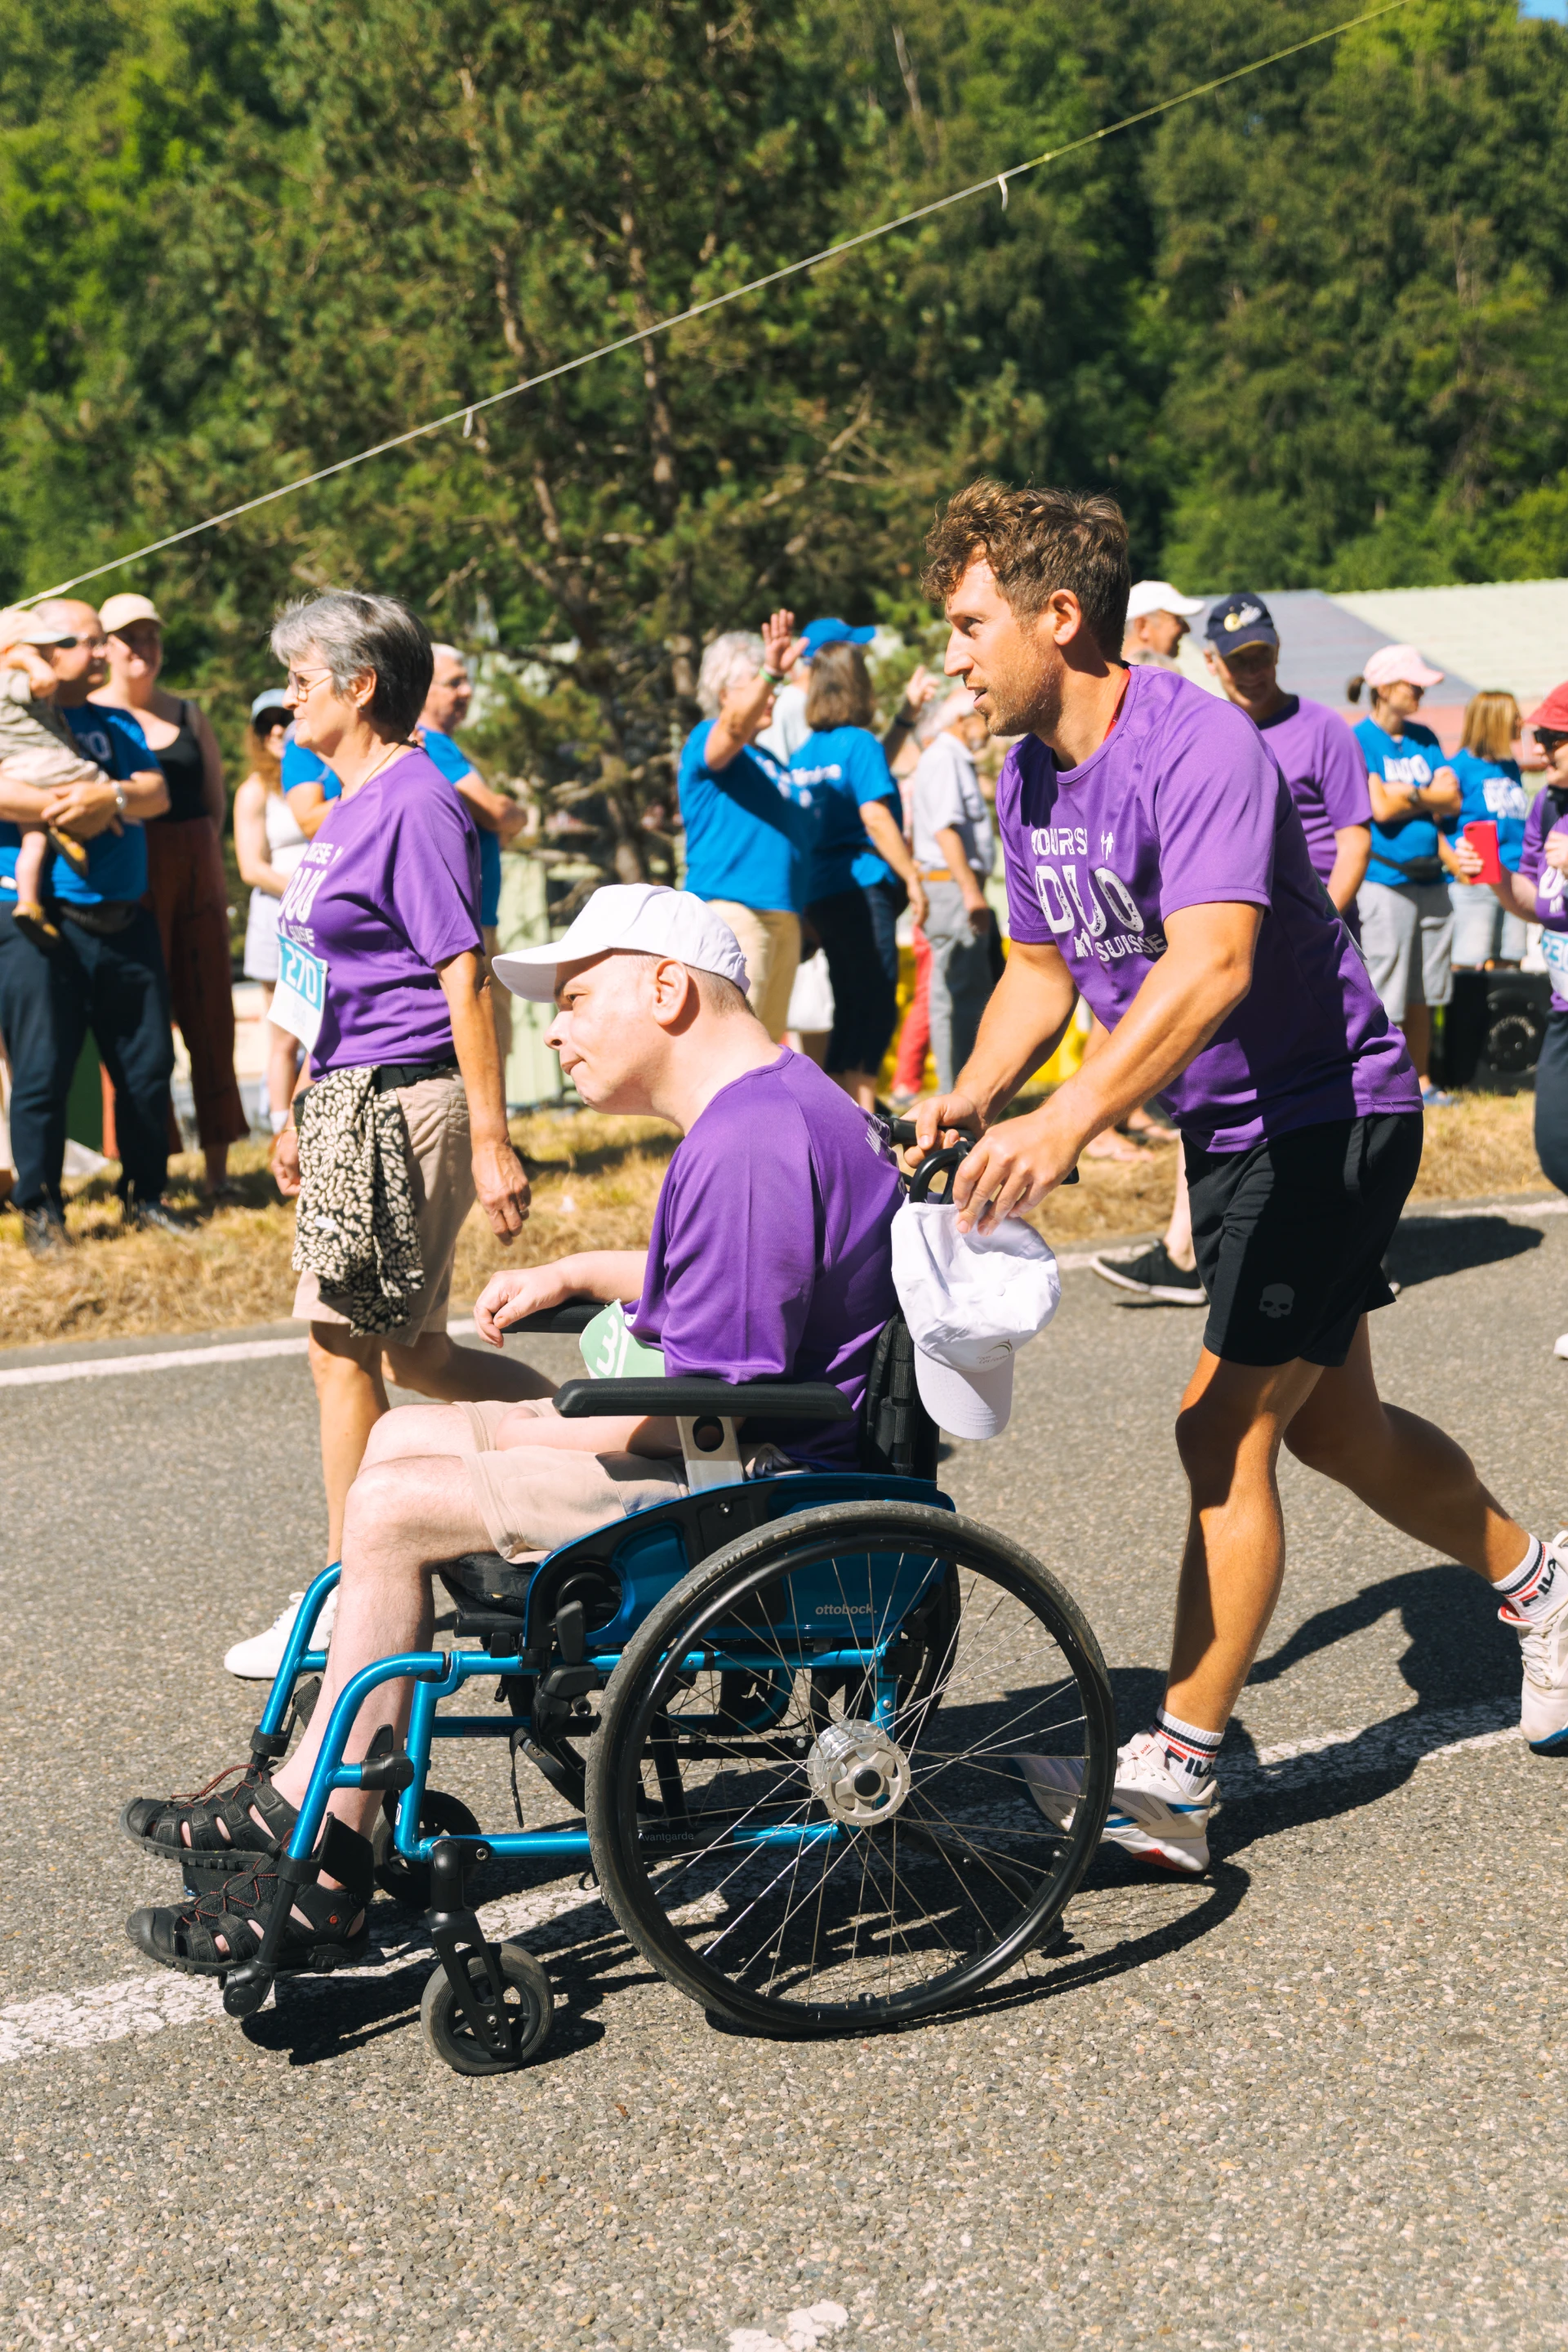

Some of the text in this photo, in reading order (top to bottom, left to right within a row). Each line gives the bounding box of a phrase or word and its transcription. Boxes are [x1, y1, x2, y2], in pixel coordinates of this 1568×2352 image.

[1036, 865, 1144, 937] DUO
[1094, 933, 1168, 962] SUISSE
[285, 942, 318, 1004] 270
[679, 1524, 807, 1606] SCHWALBE
[1519, 1557, 1557, 1607] FILA
[1165, 1744, 1213, 1778] FILA
[639, 1831, 694, 1842] Avantgarde
